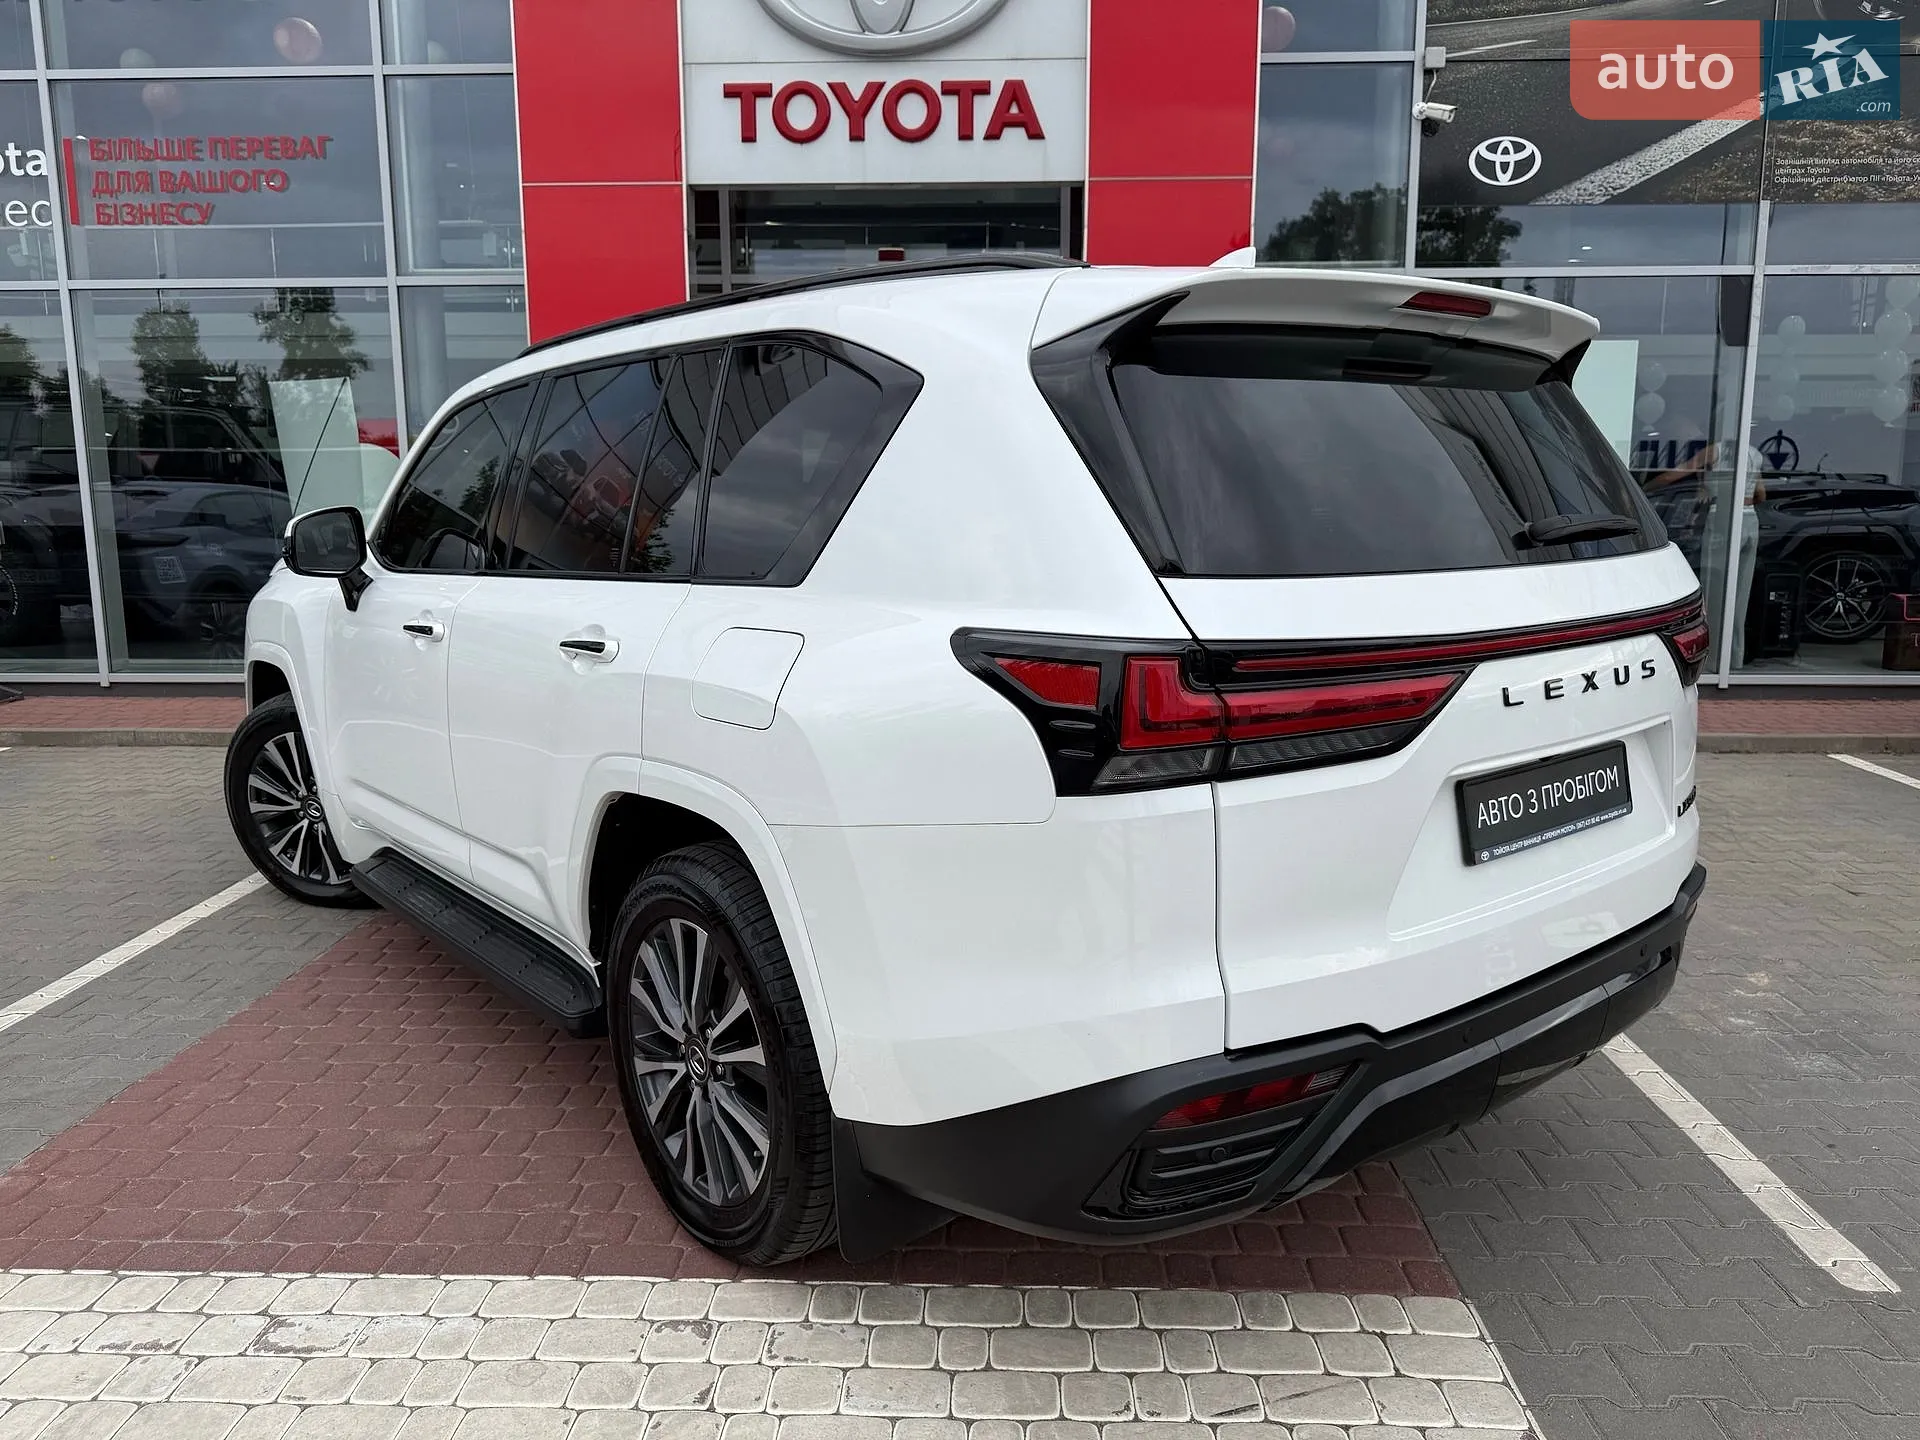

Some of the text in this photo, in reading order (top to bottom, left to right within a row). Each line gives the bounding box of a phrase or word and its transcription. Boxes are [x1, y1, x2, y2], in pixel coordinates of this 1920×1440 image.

[723, 79, 1046, 143] TOYOTA
[0, 142, 49, 176] ta
[89, 136, 334, 161] БІЛЬШЕ ПЕРЕВАГ
[92, 168, 291, 198] ДЛЯ ВАШОГО
[1807, 166, 1830, 175] Toyota
[95, 202, 215, 226] БІЗНЕСУ
[1502, 659, 1656, 707] LEXUS
[1478, 793, 1523, 828] АВТО
[1541, 765, 1619, 810] ПРОБІГОМ
